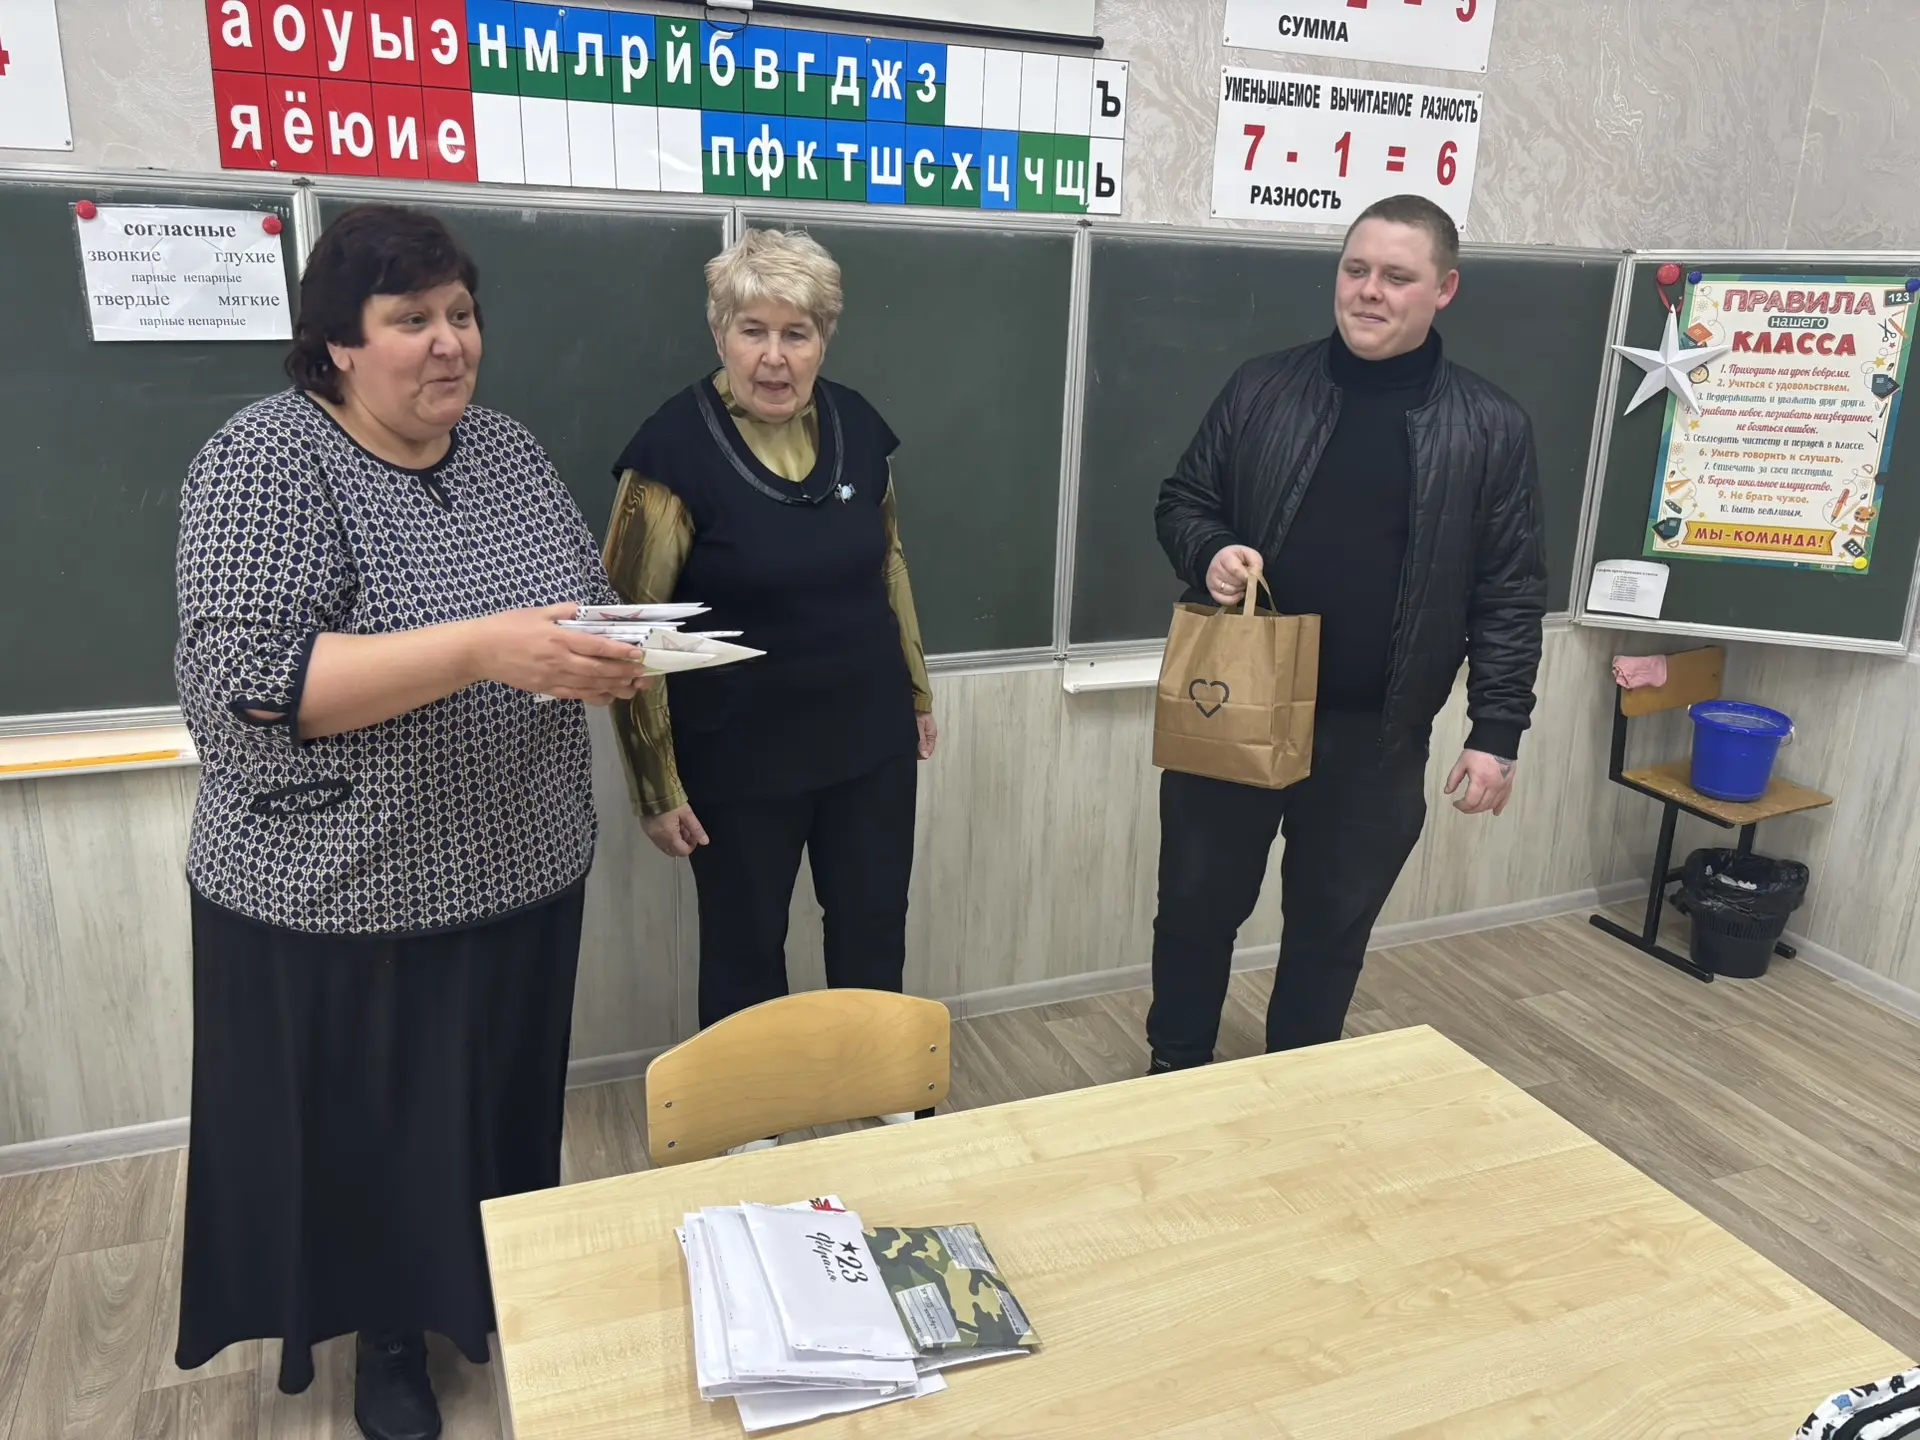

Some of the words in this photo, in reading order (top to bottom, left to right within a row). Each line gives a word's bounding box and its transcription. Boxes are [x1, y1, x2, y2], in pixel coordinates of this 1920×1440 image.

[1278, 14, 1349, 43] СУММА
[1224, 75, 1321, 110] УМЕНЬШАЕМОЕ
[1330, 86, 1414, 117] ВЫЧИТАЕМОЕ
[1419, 95, 1479, 124] РАЗНОСТЬ
[1243, 123, 1266, 171] 7
[1334, 131, 1352, 178] 1
[1436, 140, 1458, 186] 6
[1250, 185, 1342, 210] РАЗНОСТЬ
[124, 223, 236, 238] согласные
[88, 249, 162, 263] звонкие
[214, 250, 276, 266] глухие
[131, 272, 177, 284] парные
[183, 272, 242, 284] непарные
[93, 292, 171, 309] твердые
[218, 294, 281, 307] мягкие
[1723, 289, 1876, 315] ПРАВИЛА
[1888, 292, 1910, 303] 123
[139, 315, 185, 328] парные
[187, 315, 247, 328] непарные
[1770, 316, 1827, 329] нашего
[1732, 329, 1857, 357] КЛАССА
[1728, 364, 1777, 377] Приходить
[1779, 367, 1789, 376] на
[1790, 368, 1811, 379] урок
[1811, 366, 1851, 379] вовремя.
[1717, 379, 1725, 388] 2.
[1728, 379, 1765, 389] Учиться
[1775, 382, 1850, 392] удовольствием.
[1706, 393, 1767, 403] Поддерживать
[1777, 396, 1816, 406] уважать
[1819, 398, 1837, 407] друг
[1738, 408, 1764, 418] новое,
[1765, 411, 1813, 421] познавать
[1814, 412, 1874, 424] неизведанное,
[1736, 423, 1746, 431] не
[1747, 423, 1783, 433] бояться
[1693, 433, 1739, 444] Соблюдать
[1742, 437, 1780, 447] чистоту
[1699, 448, 1707, 457] 6.
[1711, 448, 1740, 458] Уметь
[1743, 452, 1787, 462] говорить
[1799, 453, 1843, 464] слушать.
[1708, 475, 1736, 487] Беречь
[1730, 492, 1743, 500] Не
[1745, 491, 1774, 502] брать
[1777, 495, 1809, 504] чужое.
[835, 1256, 868, 1284] 23
